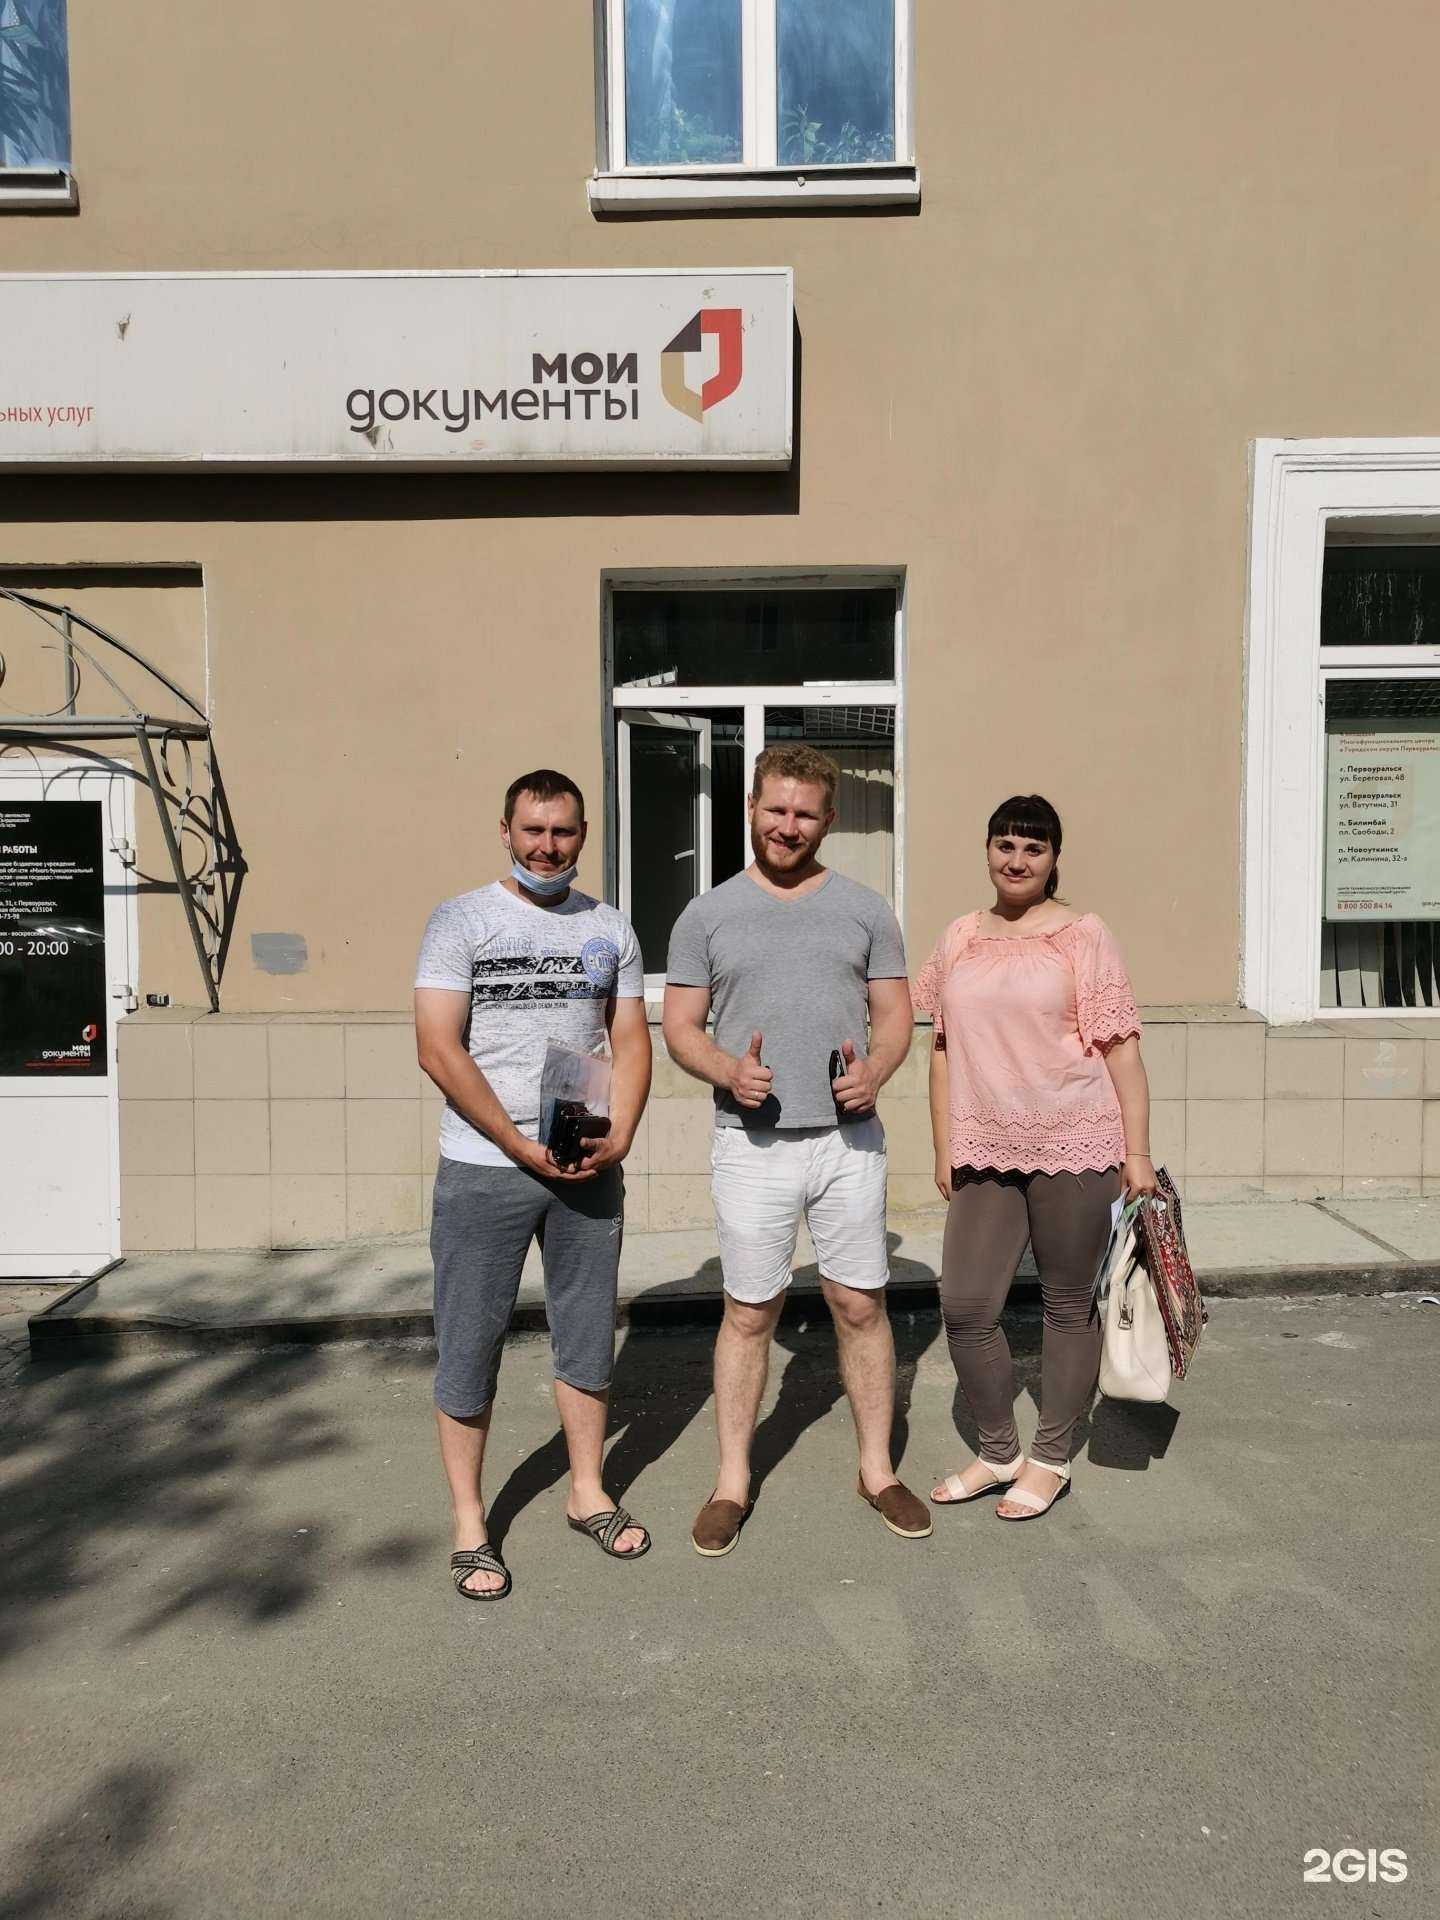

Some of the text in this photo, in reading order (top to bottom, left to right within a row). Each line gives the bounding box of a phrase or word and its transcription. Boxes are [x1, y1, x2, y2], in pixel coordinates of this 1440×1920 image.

[346, 388, 639, 433] документы
[47, 407, 94, 428] услуг
[1347, 765, 1402, 773] Первоуральск
[1352, 774, 1394, 782] Береговая,
[1347, 792, 1402, 801] Первоуральск
[1352, 801, 1389, 809] Ватутина,
[1347, 818, 1387, 826] Билимбай
[1351, 828, 1389, 837] Свободы,
[2, 845, 38, 854] РАБОТЫ
[1347, 846, 1399, 854] Новоуткинск
[1338, 856, 1349, 864] ул.
[1351, 855, 1391, 863] Калинина,
[27, 941, 69, 956] 20:00
[42, 1050, 91, 1059] документы
